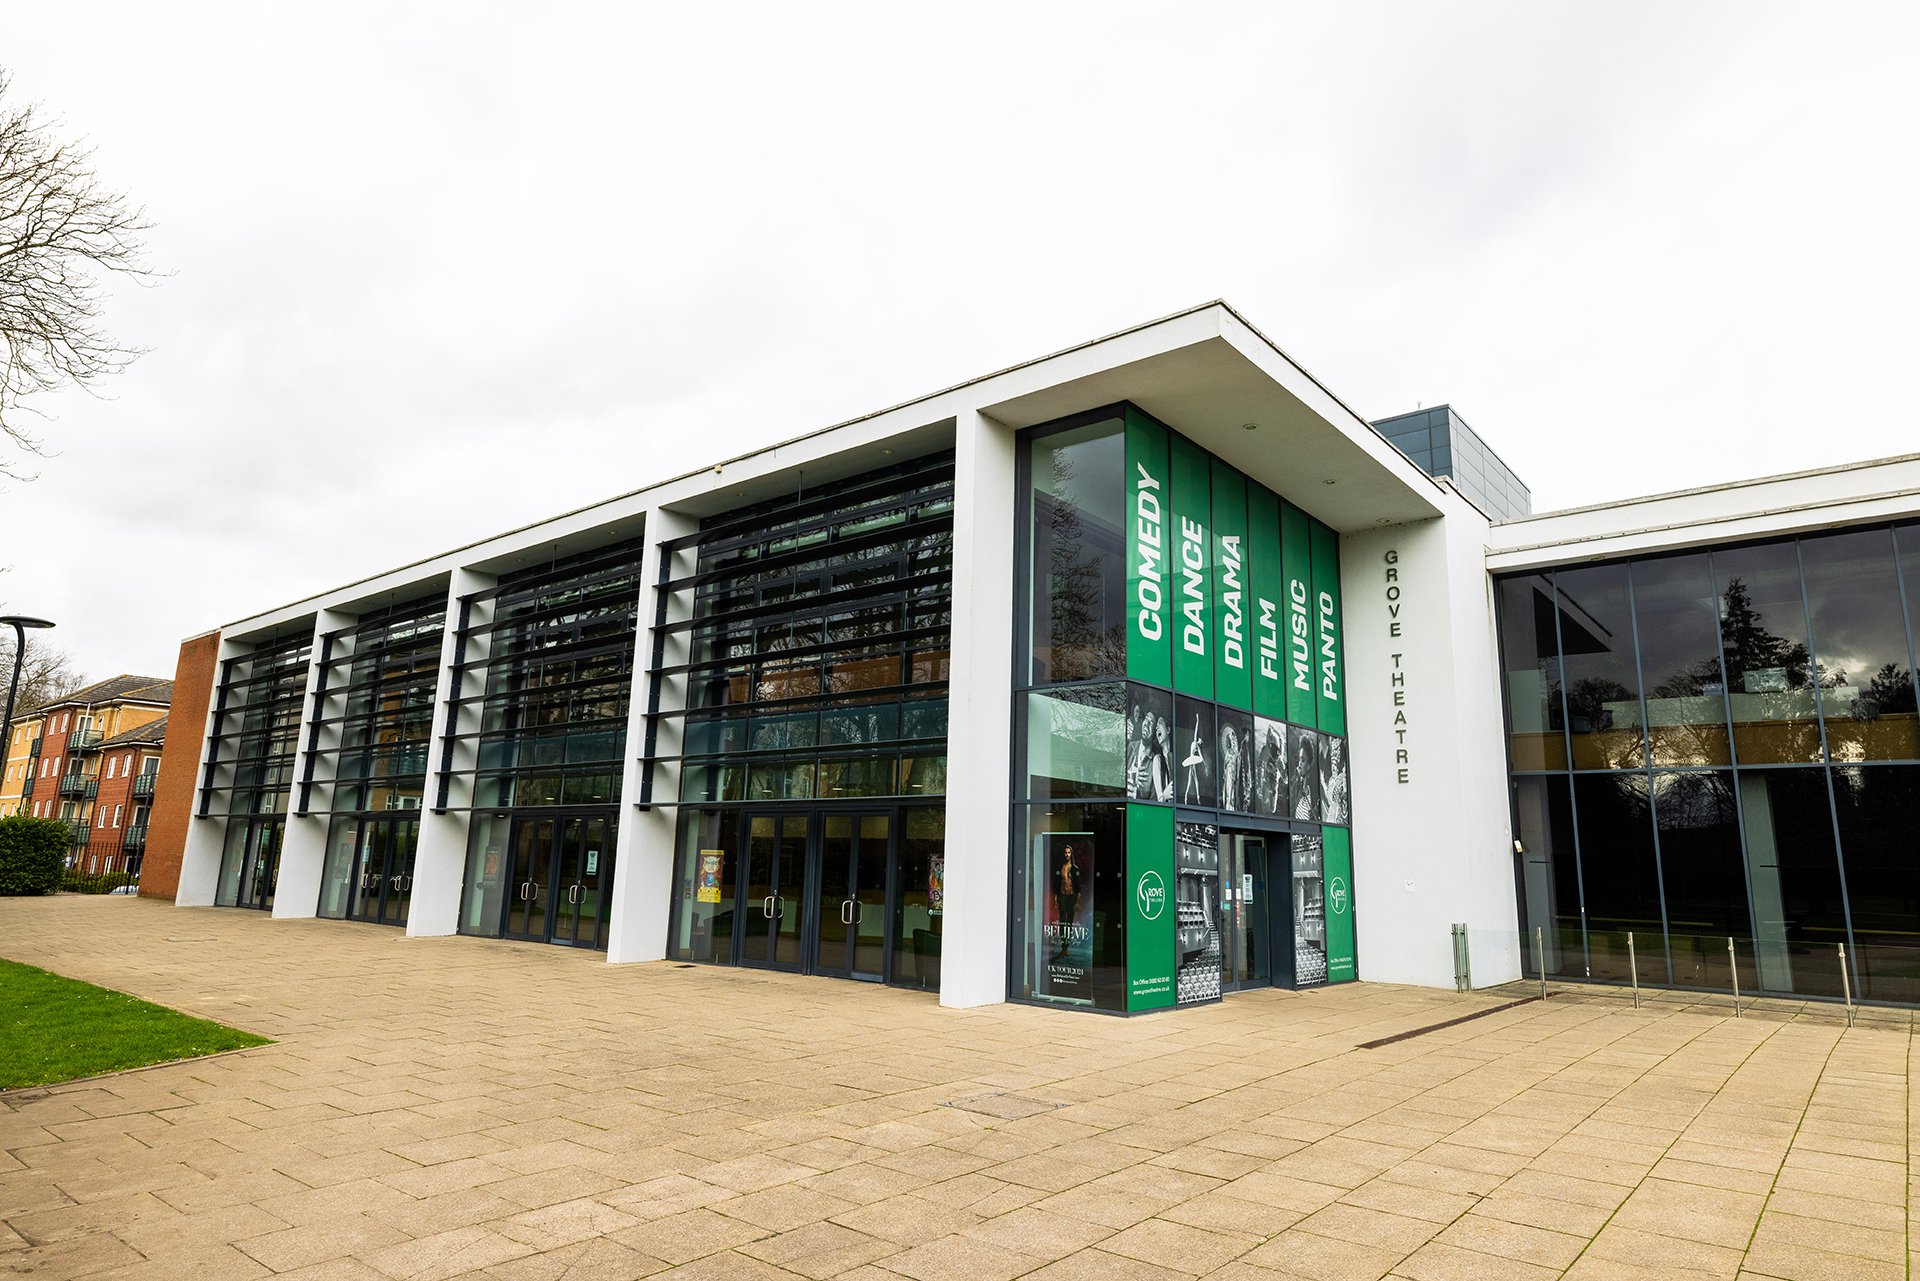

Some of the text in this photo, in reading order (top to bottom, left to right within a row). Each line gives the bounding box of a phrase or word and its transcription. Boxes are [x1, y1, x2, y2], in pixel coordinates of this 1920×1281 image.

[1137, 461, 1162, 642] COMEDY
[1181, 515, 1205, 656] DANCE
[1222, 535, 1244, 670] DRAMA
[1259, 597, 1279, 681] FILM
[1290, 578, 1311, 692] MUSIC
[1319, 591, 1338, 701] PANTO
[1385, 549, 1409, 784] GROVE THEATRE
[1044, 924, 1090, 940] BELIEVE
[1139, 878, 1163, 912] GROVE
